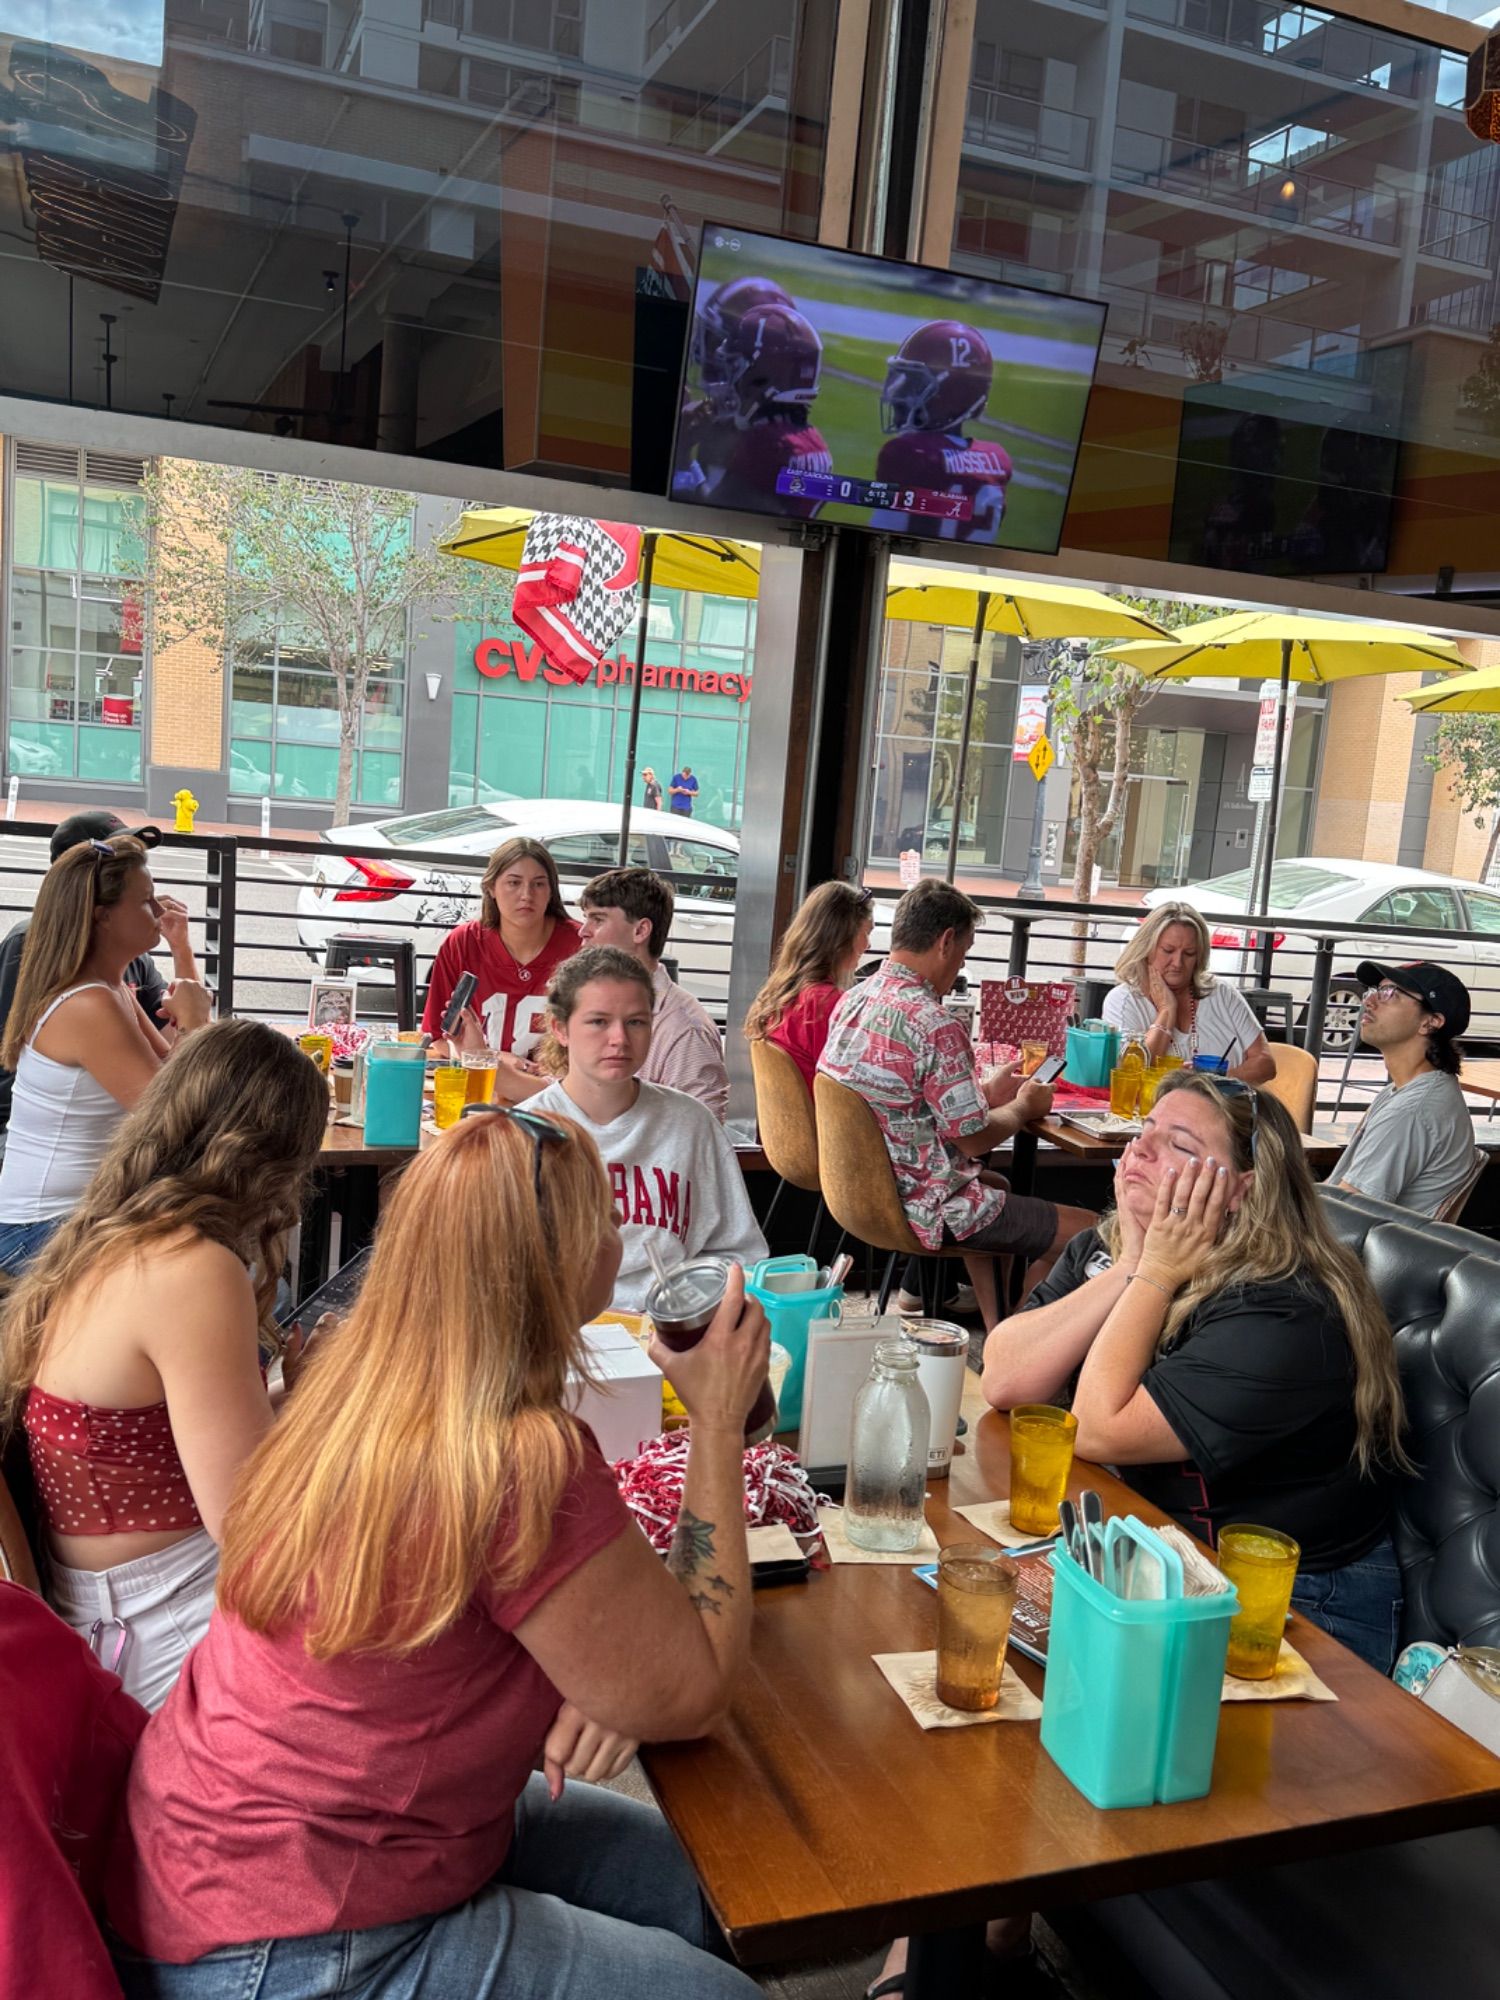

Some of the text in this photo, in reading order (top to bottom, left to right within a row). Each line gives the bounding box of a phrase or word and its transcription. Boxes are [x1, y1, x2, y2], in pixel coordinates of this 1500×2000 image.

[754, 318, 767, 347] 1
[949, 337, 972, 368] 12
[942, 448, 1006, 476] RUSSELL
[841, 481, 851, 498] 0
[904, 491, 915, 507] 3
[596, 654, 753, 703] pharmacy
